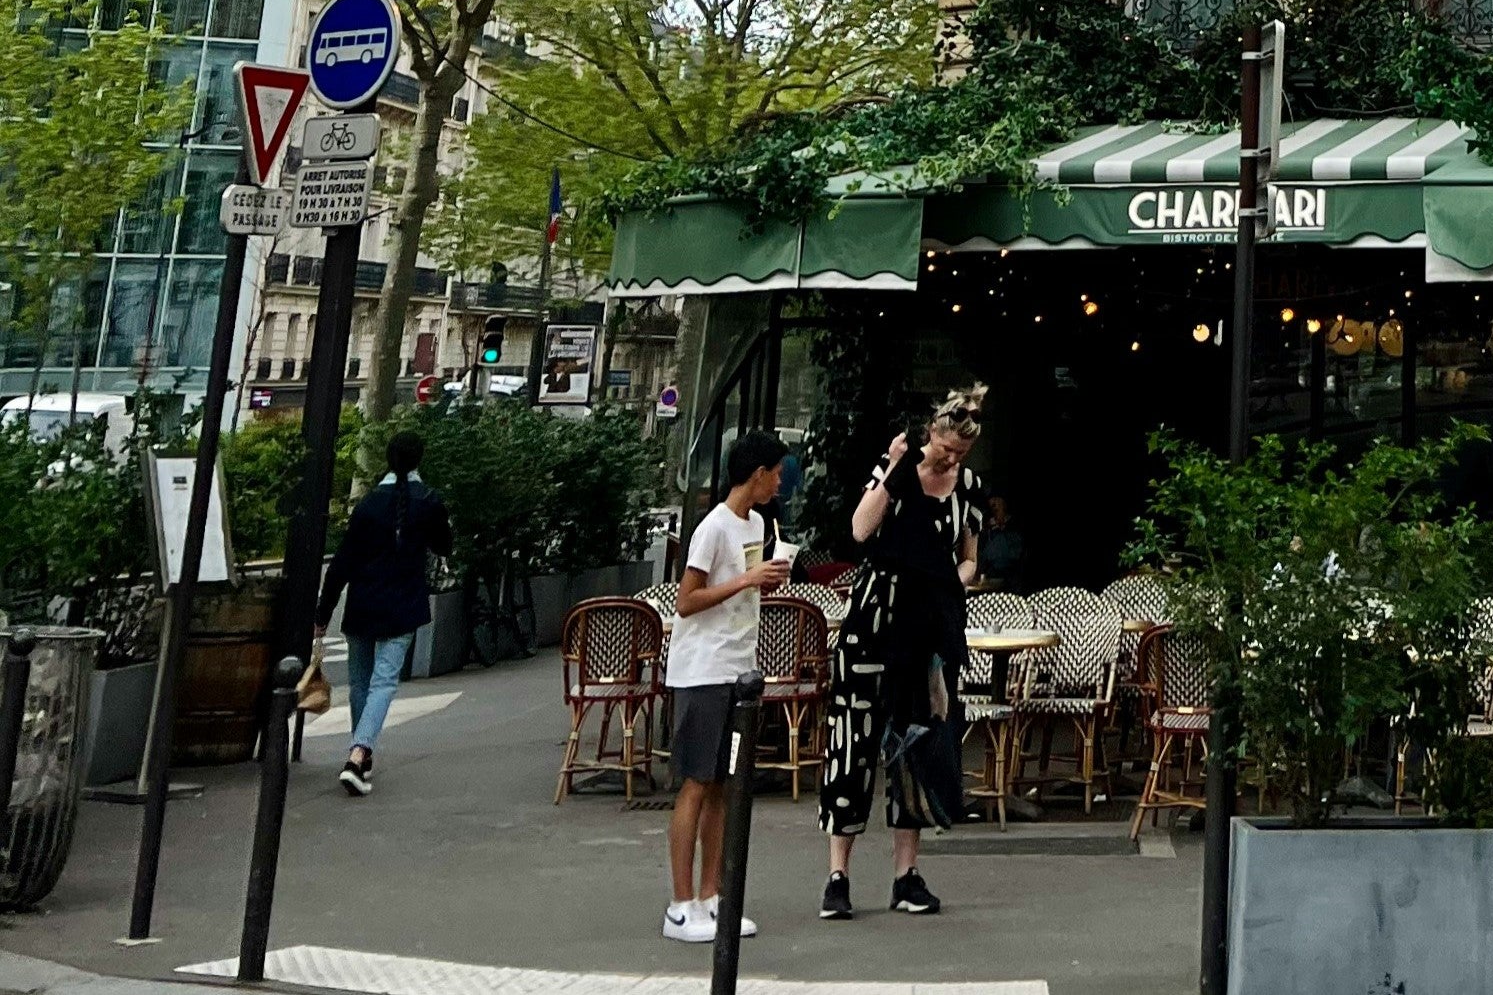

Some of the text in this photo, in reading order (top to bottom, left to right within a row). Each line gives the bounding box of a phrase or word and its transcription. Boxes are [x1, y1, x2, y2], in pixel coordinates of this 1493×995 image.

[302, 169, 366, 181] ARRET AUTORISE
[300, 183, 365, 195] POUR LIVRAISON
[271, 196, 282, 209] LE
[352, 197, 362, 207] 30
[1128, 188, 1326, 228] CHARIARI
[232, 213, 278, 227] PASSAGE
[350, 210, 360, 221] 30
[1162, 233, 1213, 243] BISTROT
[1215, 233, 1231, 243] DE
